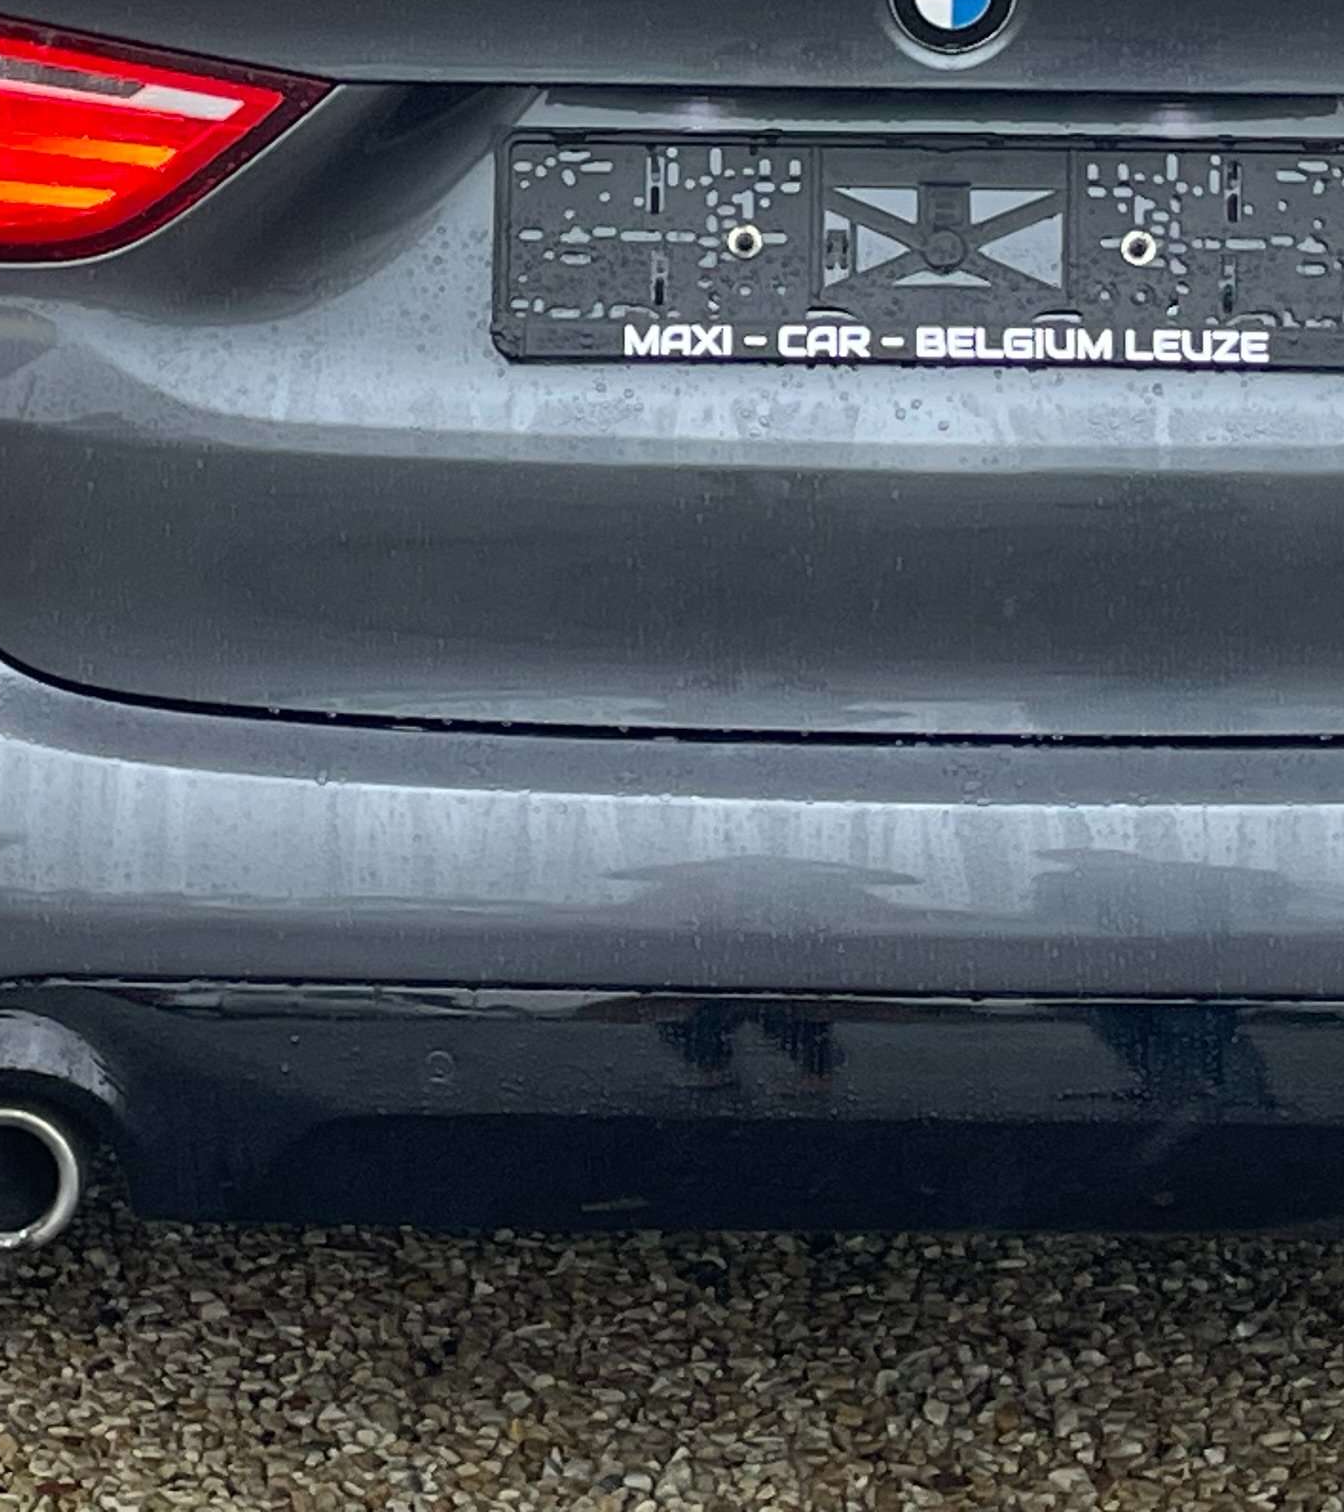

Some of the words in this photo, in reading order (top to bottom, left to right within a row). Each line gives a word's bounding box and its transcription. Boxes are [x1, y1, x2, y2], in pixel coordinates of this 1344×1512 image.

[623, 324, 732, 357] MAXI
[777, 326, 870, 357] CAR
[914, 327, 1112, 361] BELGIUM
[1123, 328, 1270, 363] LEUZE
